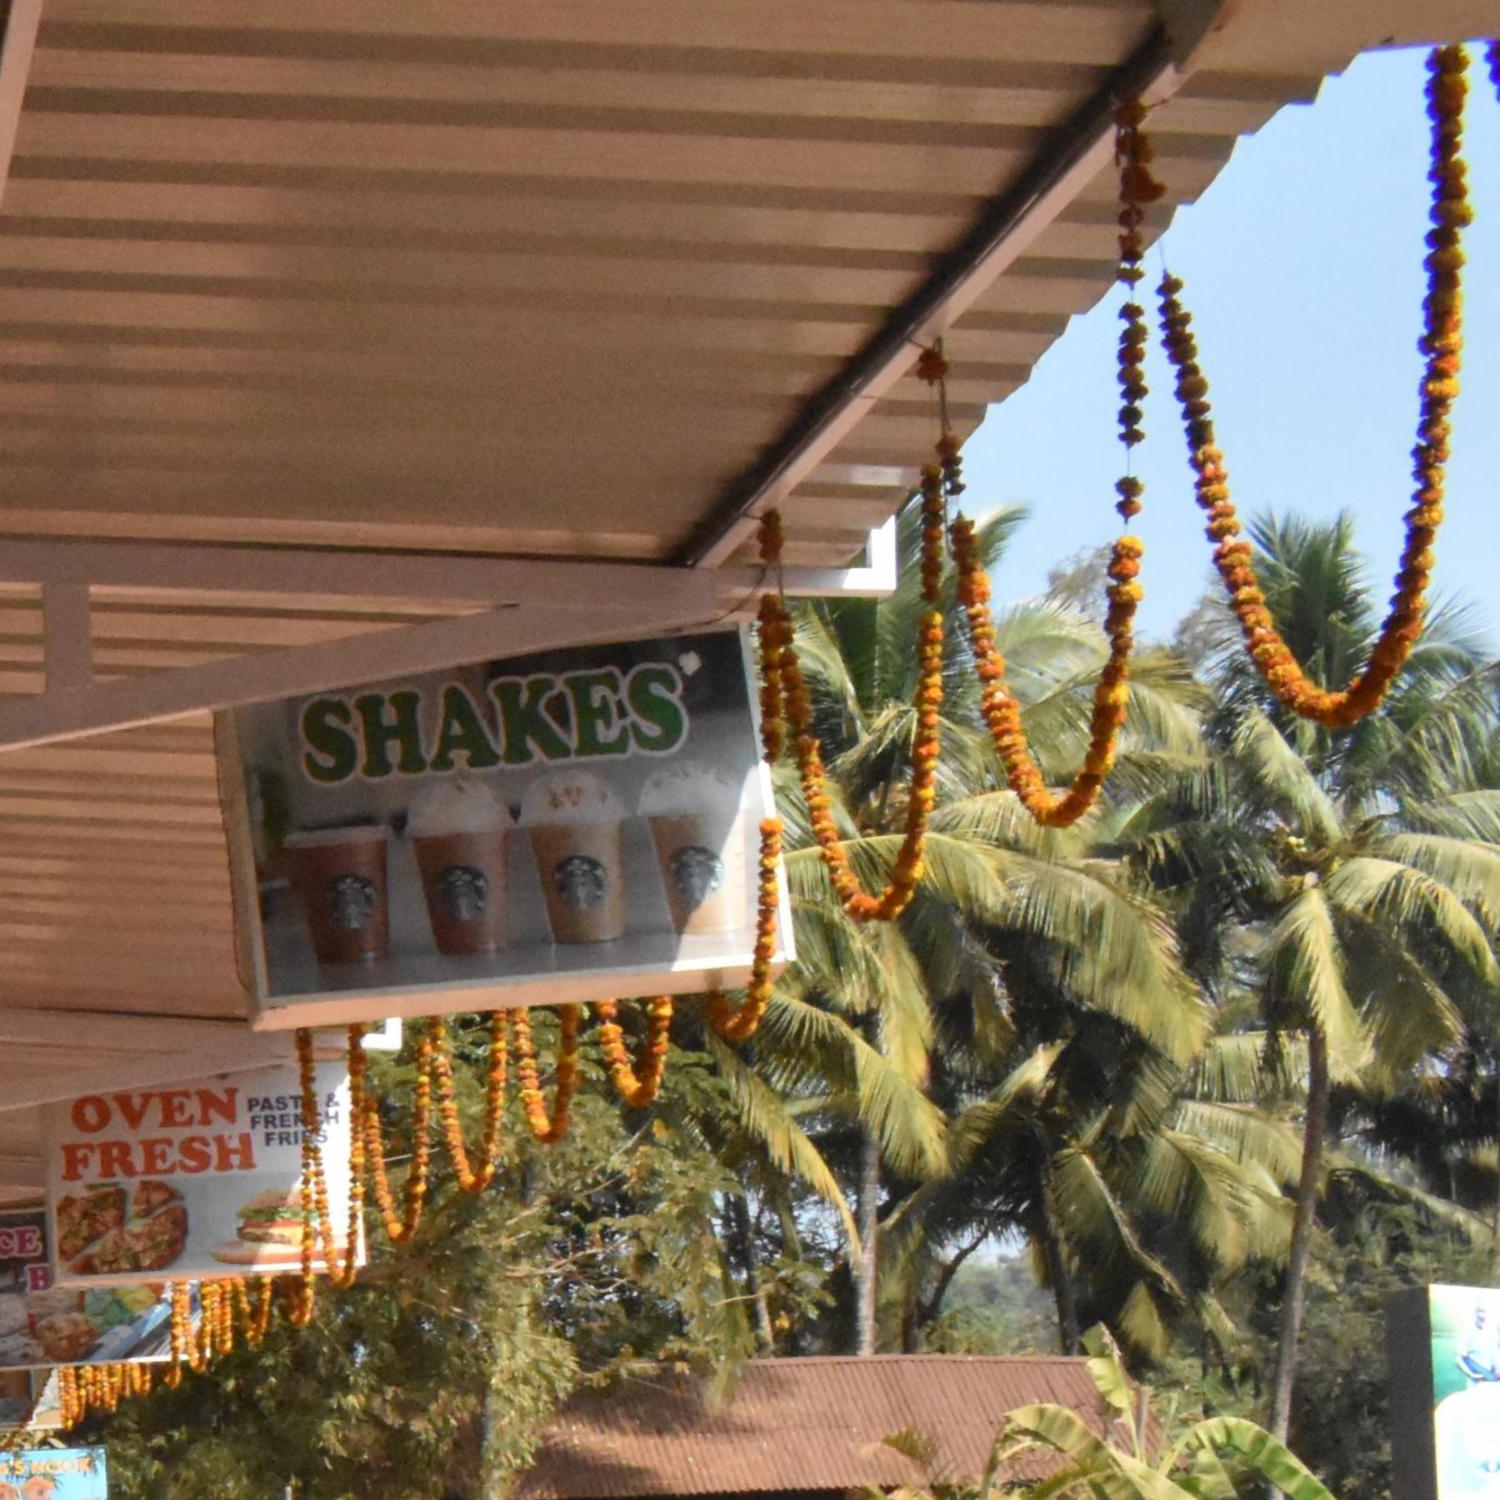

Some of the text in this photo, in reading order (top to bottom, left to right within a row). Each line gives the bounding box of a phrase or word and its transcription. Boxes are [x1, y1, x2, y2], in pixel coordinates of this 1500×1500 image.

[301, 663, 692, 785] SHAKES
[70, 1087, 239, 1134] OVEN
[247, 1094, 318, 1112] PAST
[249, 1110, 339, 1130] FRENH
[60, 1132, 256, 1181] FRESH
[31, 1456, 93, 1474] NOOK
